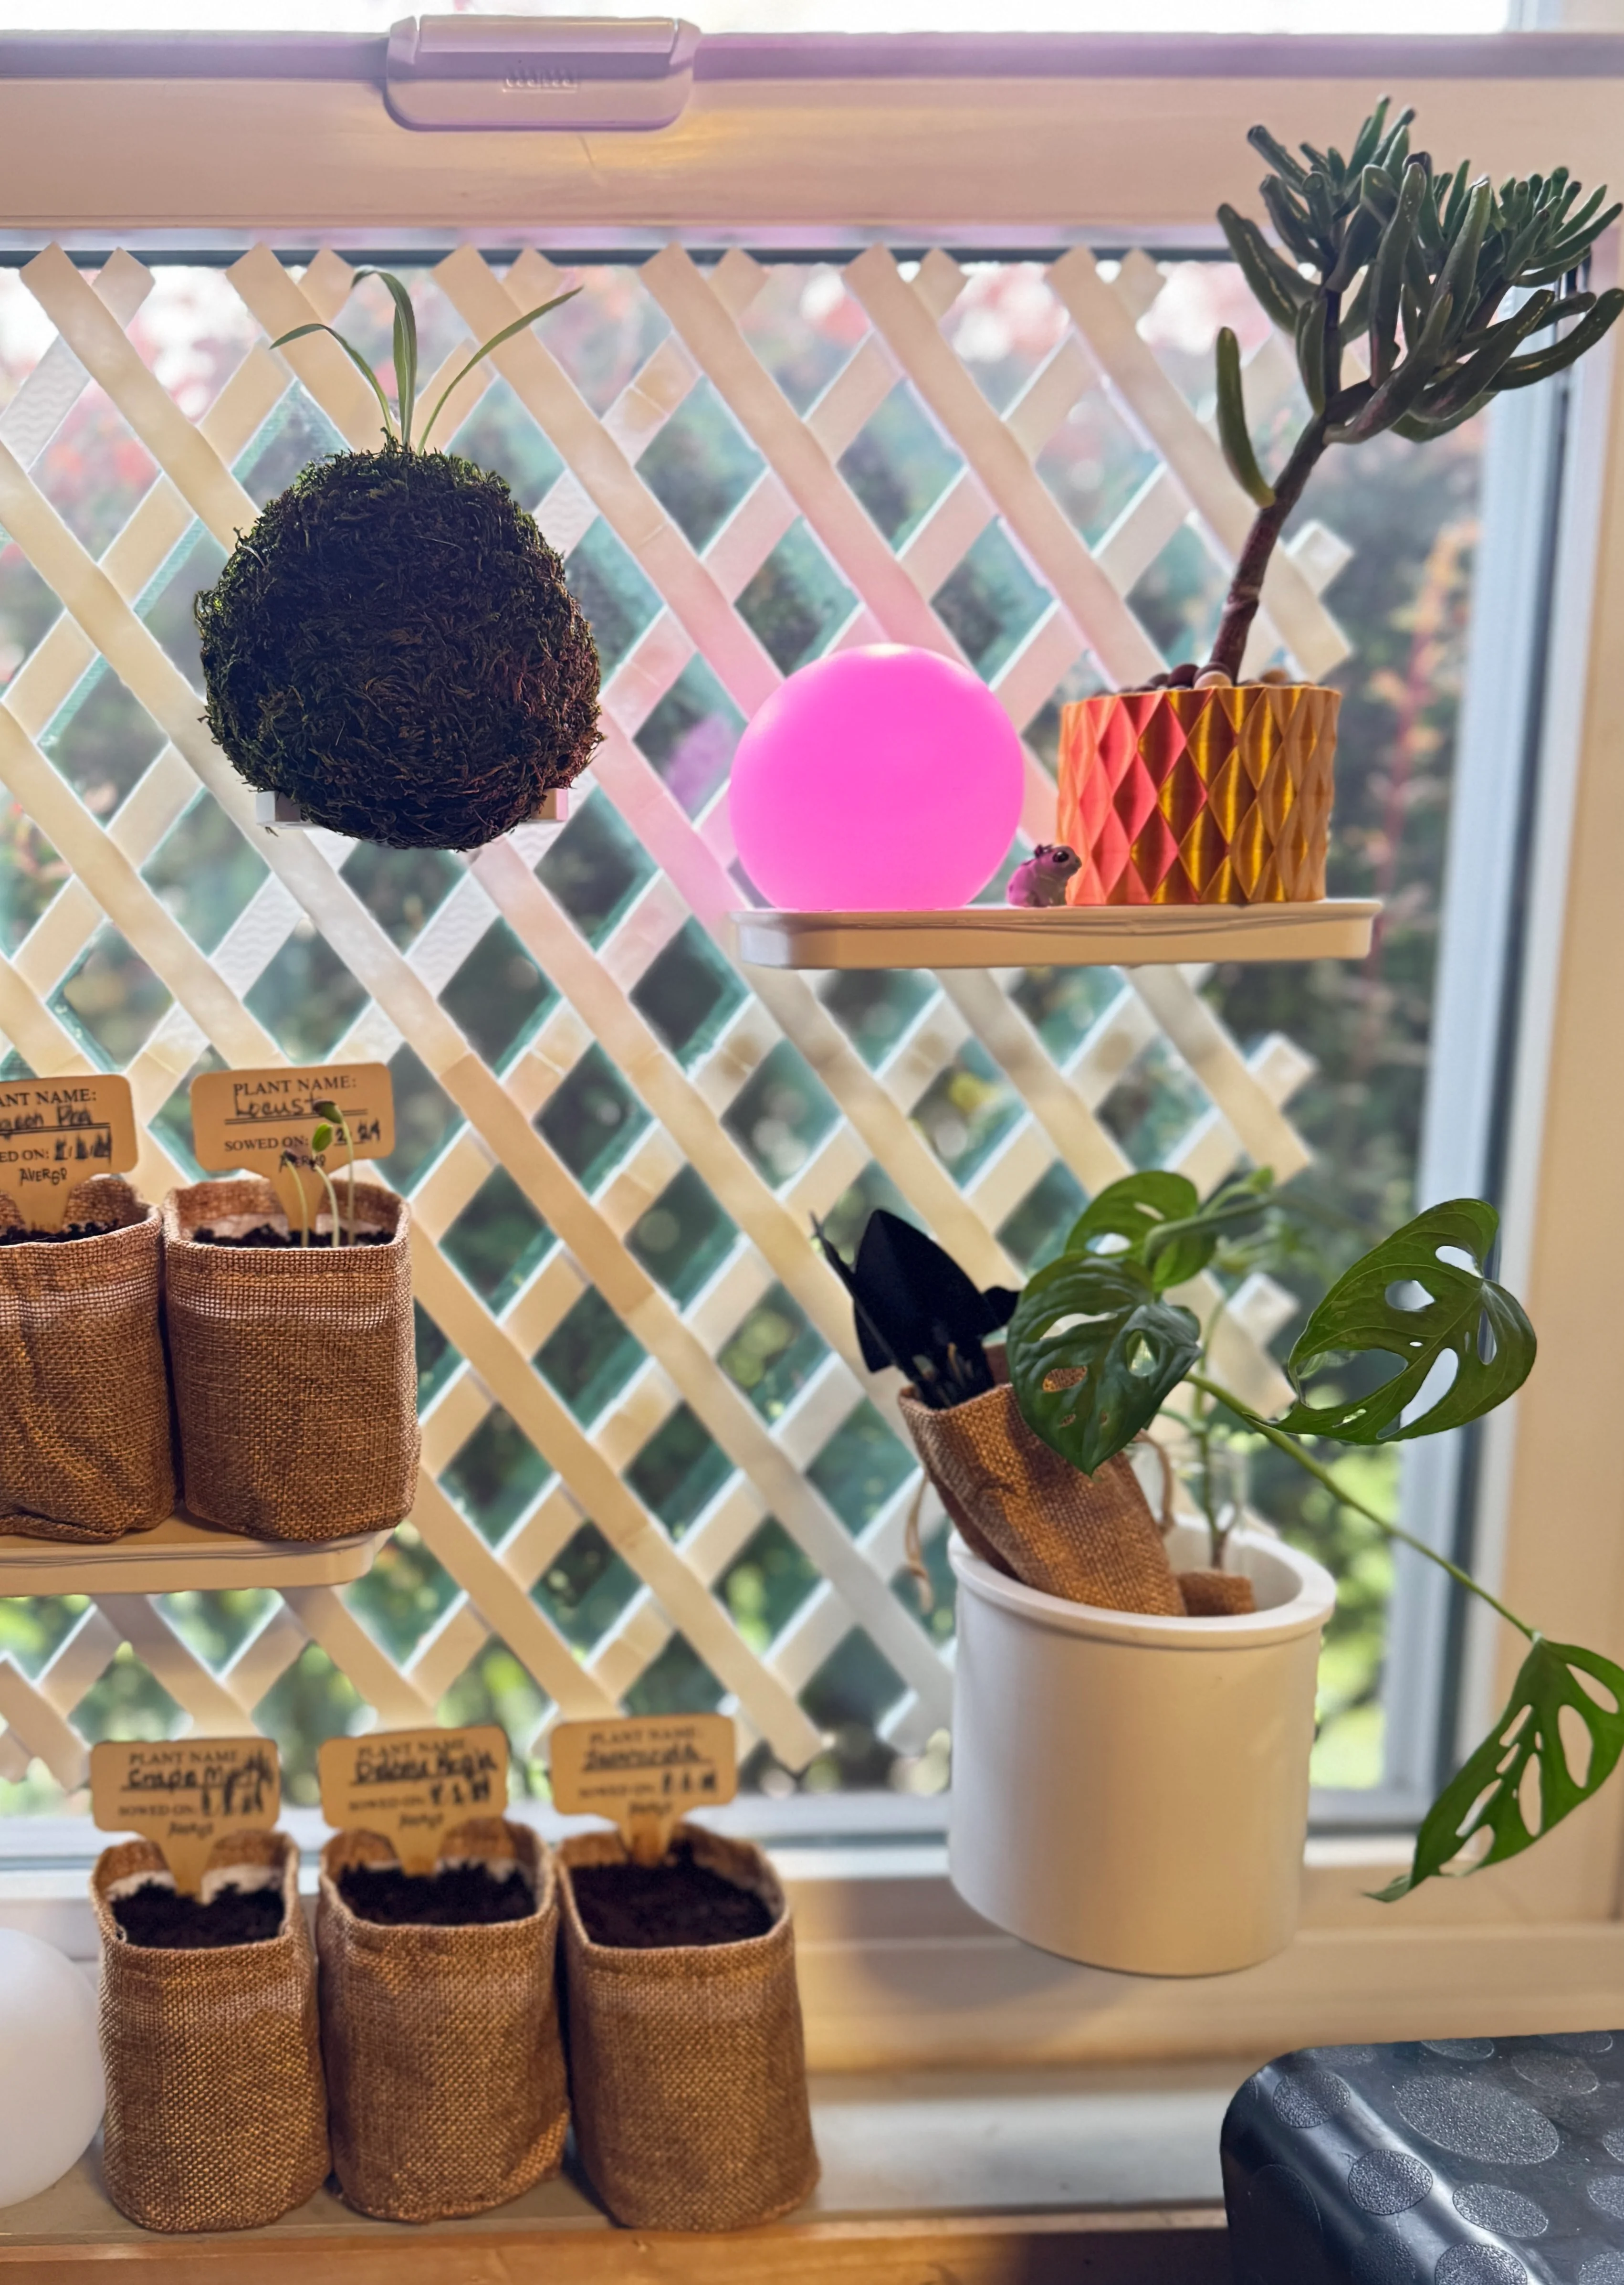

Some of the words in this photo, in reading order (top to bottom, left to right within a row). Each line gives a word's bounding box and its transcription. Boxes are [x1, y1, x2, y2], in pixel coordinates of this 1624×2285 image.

[232, 1079, 292, 1097] PLANT
[297, 1075, 356, 1092] NAME:
[35, 1088, 97, 1105] NAME:
[224, 1137, 279, 1152] SOWED
[23, 1148, 50, 1161] ON:
[129, 1751, 183, 1765] PLANT
